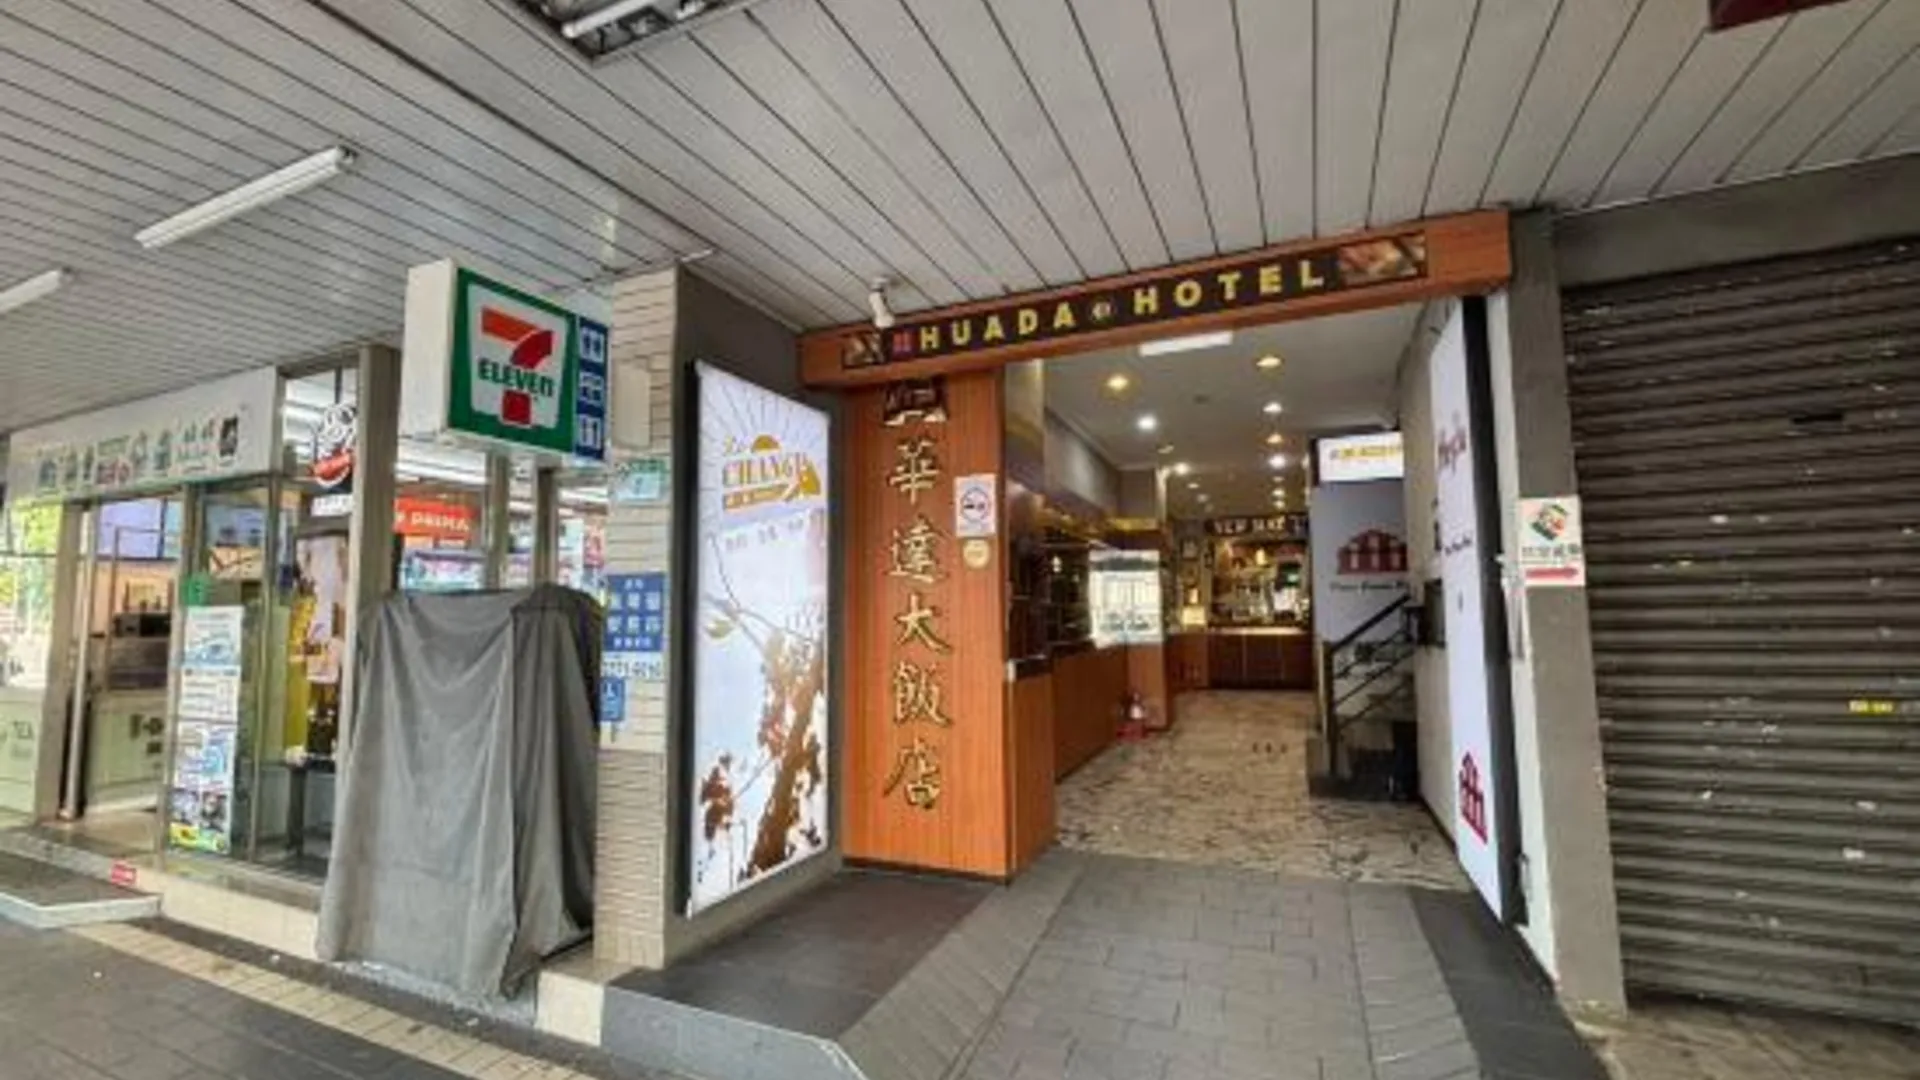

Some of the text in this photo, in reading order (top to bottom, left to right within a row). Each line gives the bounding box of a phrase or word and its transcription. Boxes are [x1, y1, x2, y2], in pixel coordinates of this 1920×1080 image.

[919, 259, 1324, 350] HUADA HOTEL
[479, 306, 556, 426] 7
[883, 437, 953, 810] 華達大飯店
